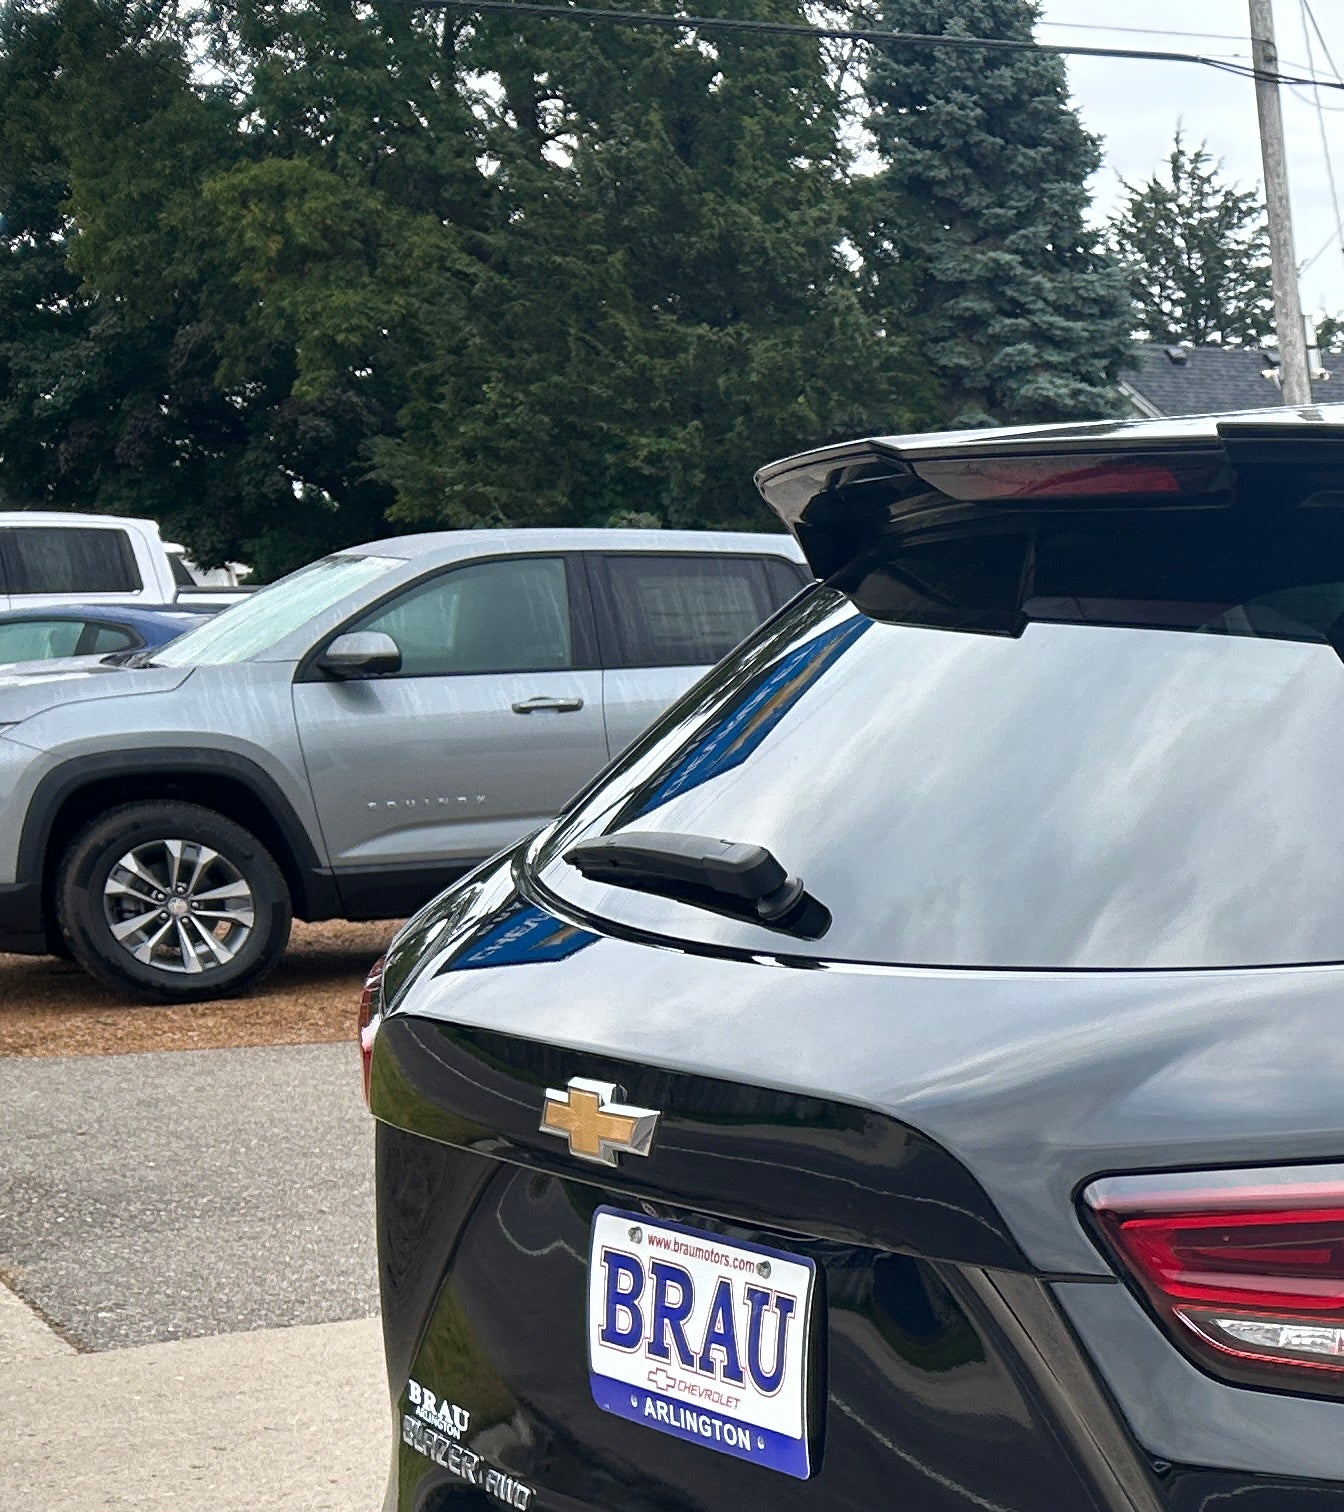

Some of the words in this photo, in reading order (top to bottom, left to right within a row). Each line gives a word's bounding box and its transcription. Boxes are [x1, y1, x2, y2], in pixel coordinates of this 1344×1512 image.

[647, 1233, 755, 1274] www.braumotors.com
[598, 1245, 798, 1398] BRAU
[408, 1378, 470, 1433] BRAU
[677, 1379, 742, 1410] CHEVROLET
[403, 1414, 482, 1484] BLAZER
[644, 1396, 751, 1451] ARLINGTON
